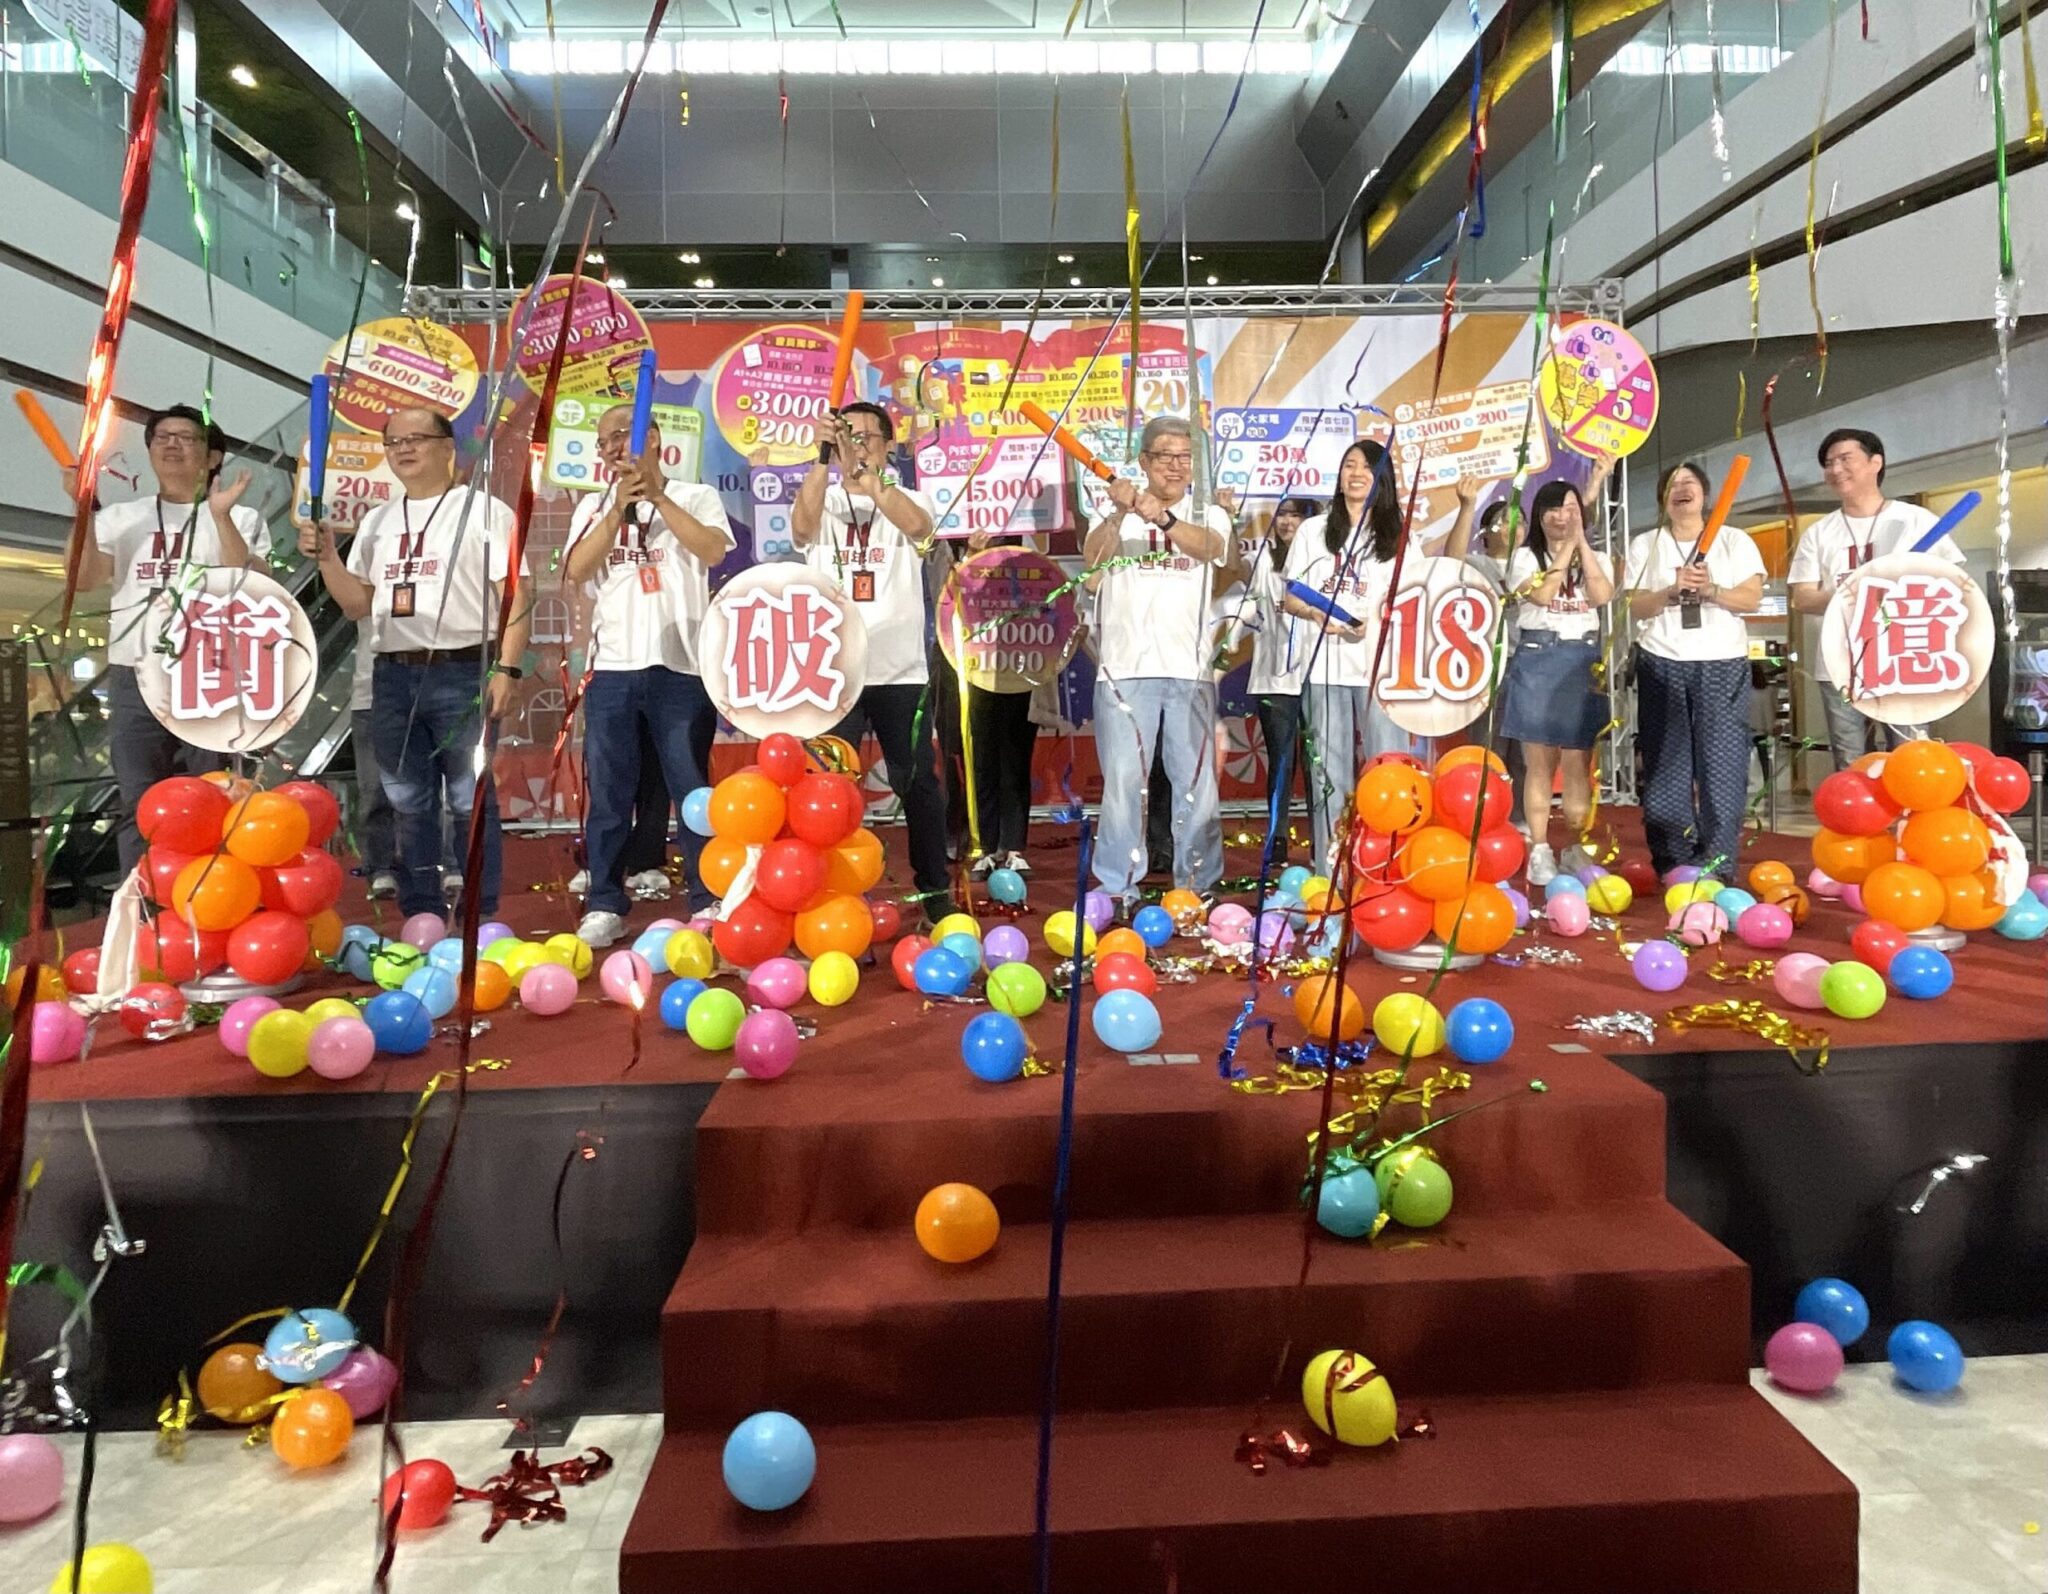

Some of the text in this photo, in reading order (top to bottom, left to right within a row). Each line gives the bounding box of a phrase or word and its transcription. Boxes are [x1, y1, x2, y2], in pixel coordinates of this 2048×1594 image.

[1612, 387, 1636, 422] 5
[758, 419, 815, 448] 200
[923, 459, 942, 472] 2F
[717, 473, 749, 493] 10.
[758, 485, 778, 498] 1F
[966, 505, 1010, 530] 100
[727, 590, 841, 707] 破
[1380, 591, 1492, 697] 18
[1852, 579, 1965, 694] 億
[168, 594, 286, 716] 衝
